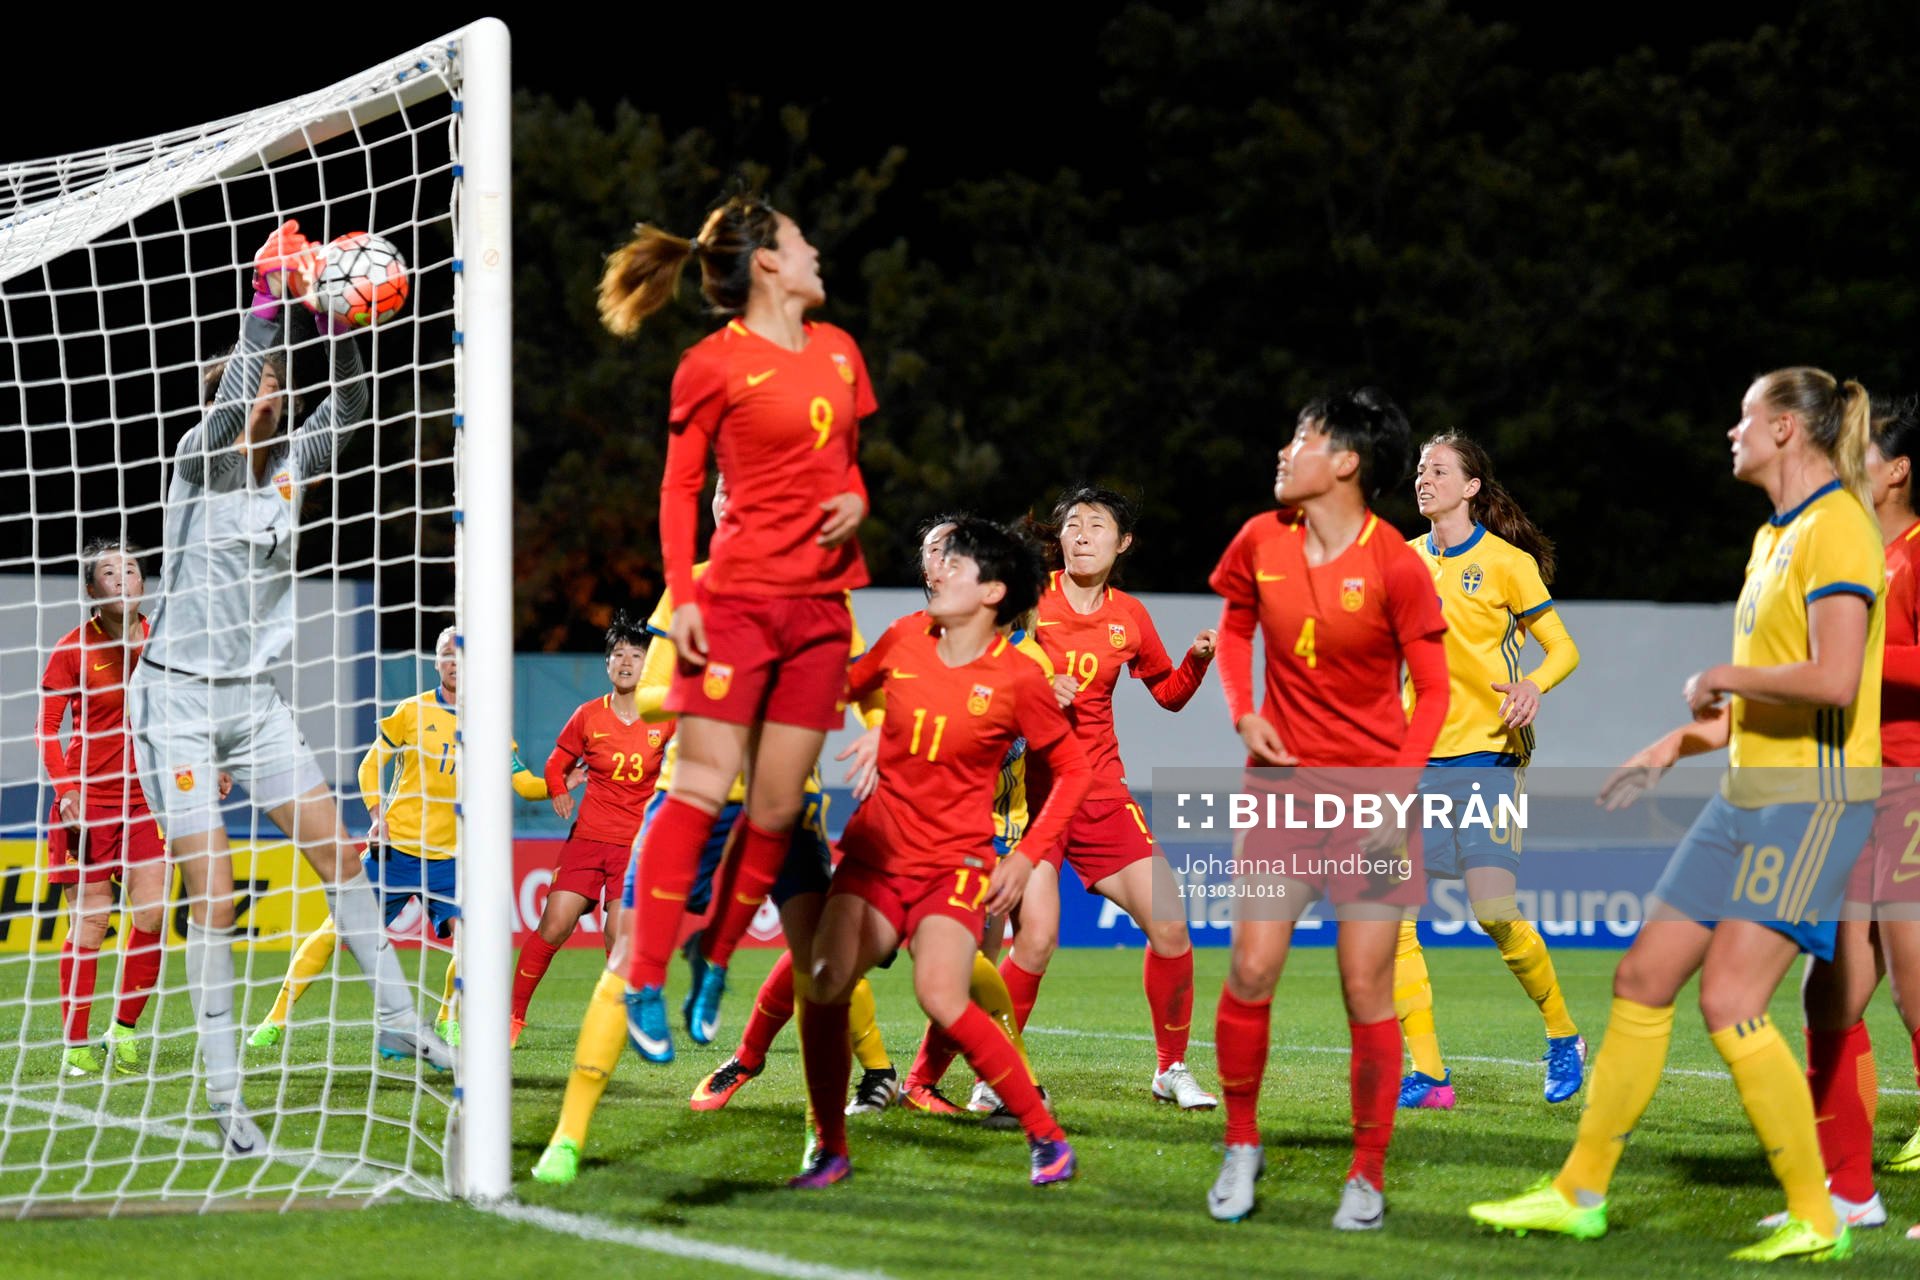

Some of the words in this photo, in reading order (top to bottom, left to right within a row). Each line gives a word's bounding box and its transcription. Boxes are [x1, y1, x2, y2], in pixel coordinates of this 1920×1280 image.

[809, 396, 833, 450] 9
[1294, 616, 1317, 669] 4
[1065, 650, 1098, 692] 19
[909, 708, 948, 762] 11
[611, 751, 645, 783] 23
[954, 869, 989, 911] 11
[1731, 844, 1785, 905] 18
